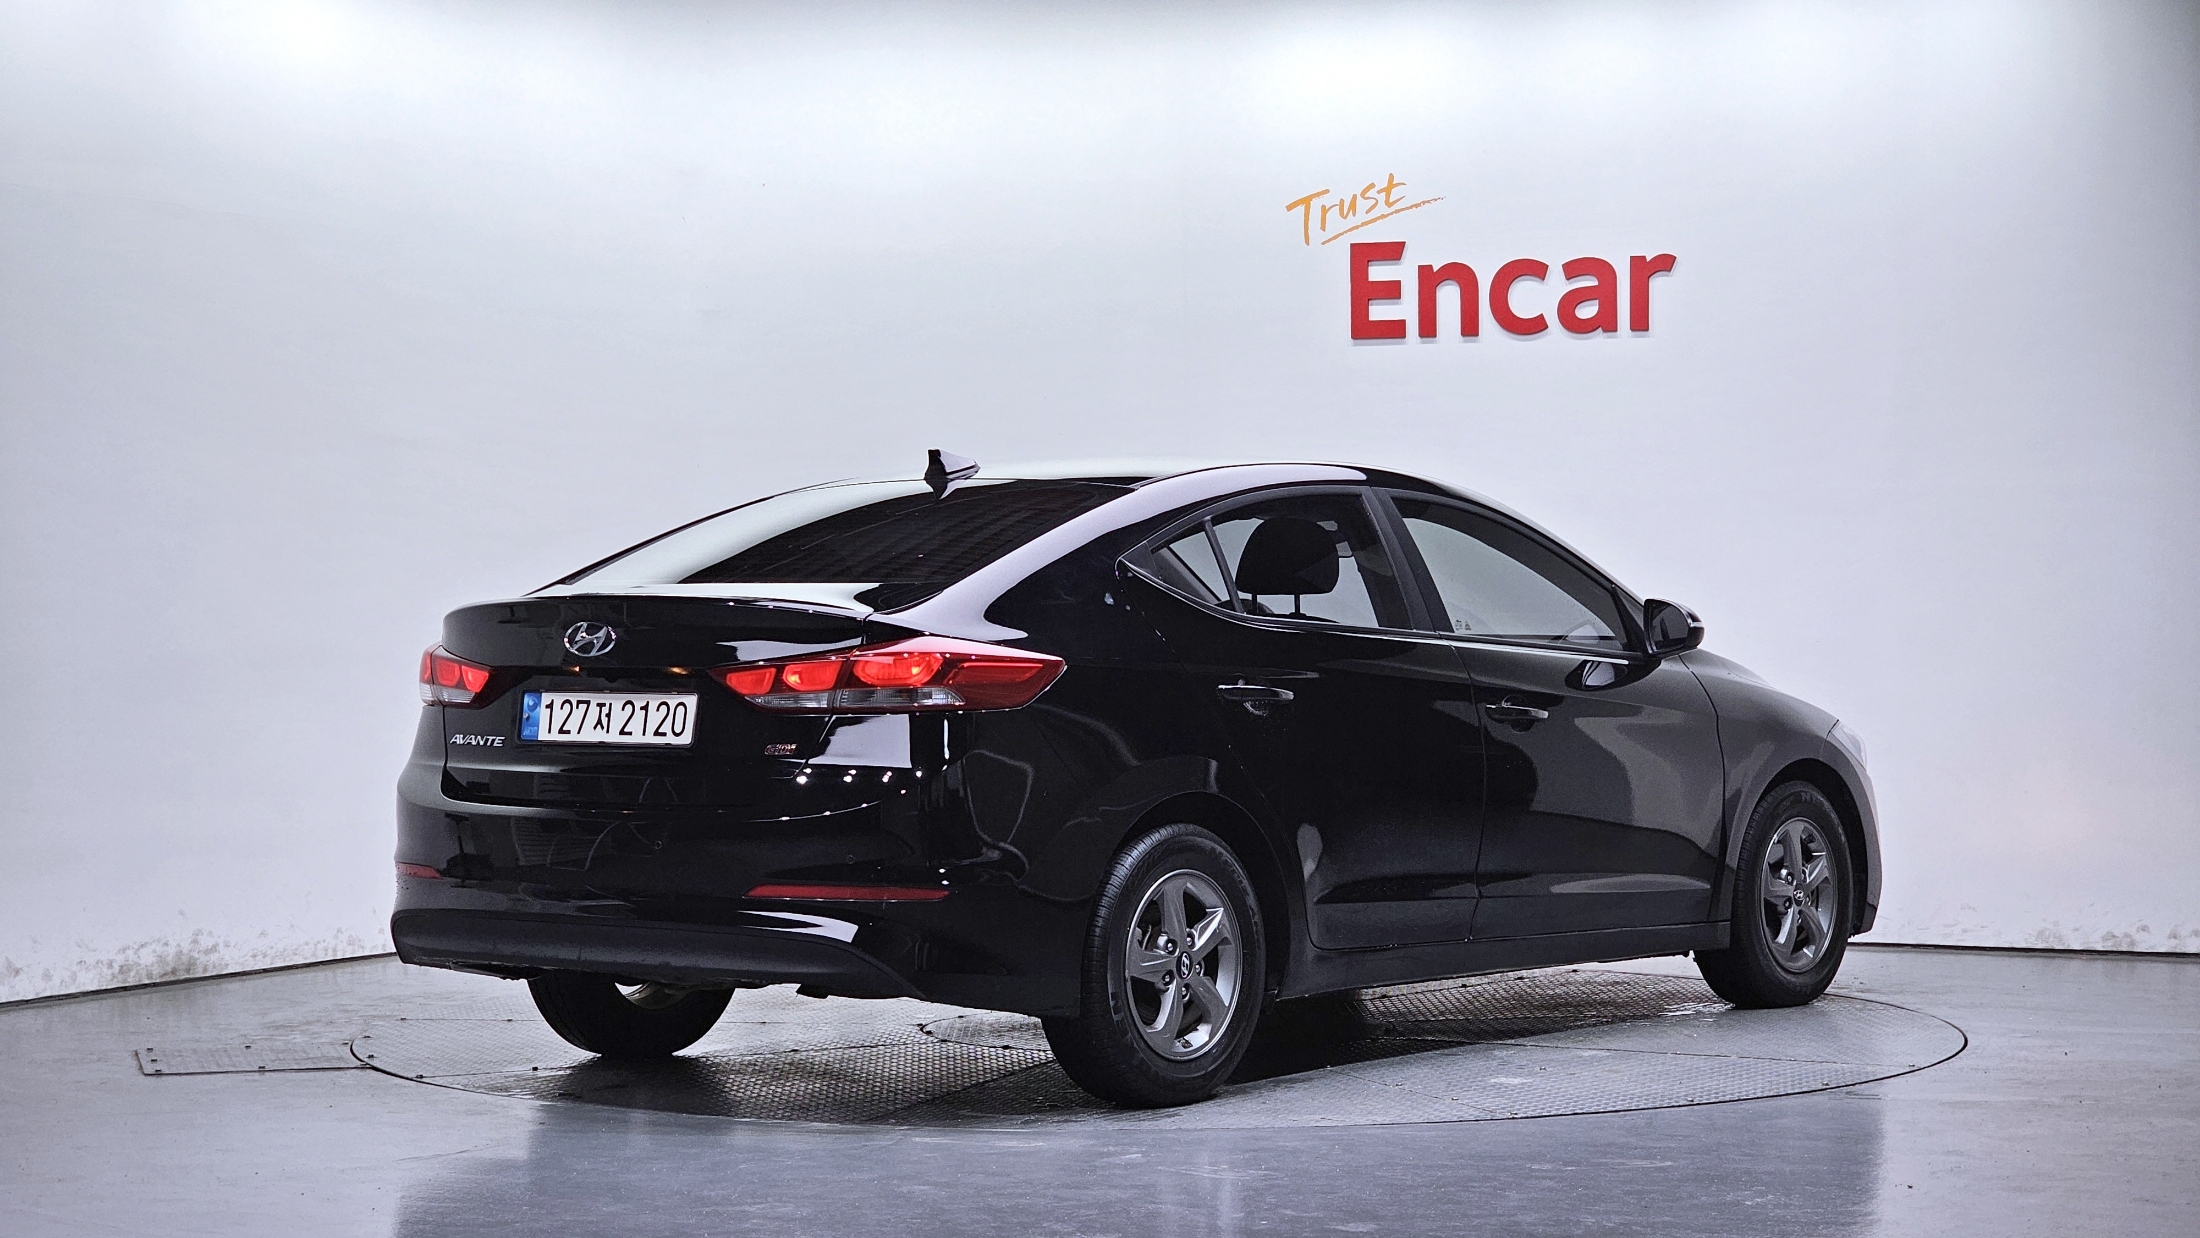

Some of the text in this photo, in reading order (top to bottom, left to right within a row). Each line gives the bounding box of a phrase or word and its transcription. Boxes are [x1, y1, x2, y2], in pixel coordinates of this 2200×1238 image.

[1286, 173, 1407, 246] Trust
[1350, 241, 1677, 340] Encar
[449, 734, 505, 747] AVANTE
